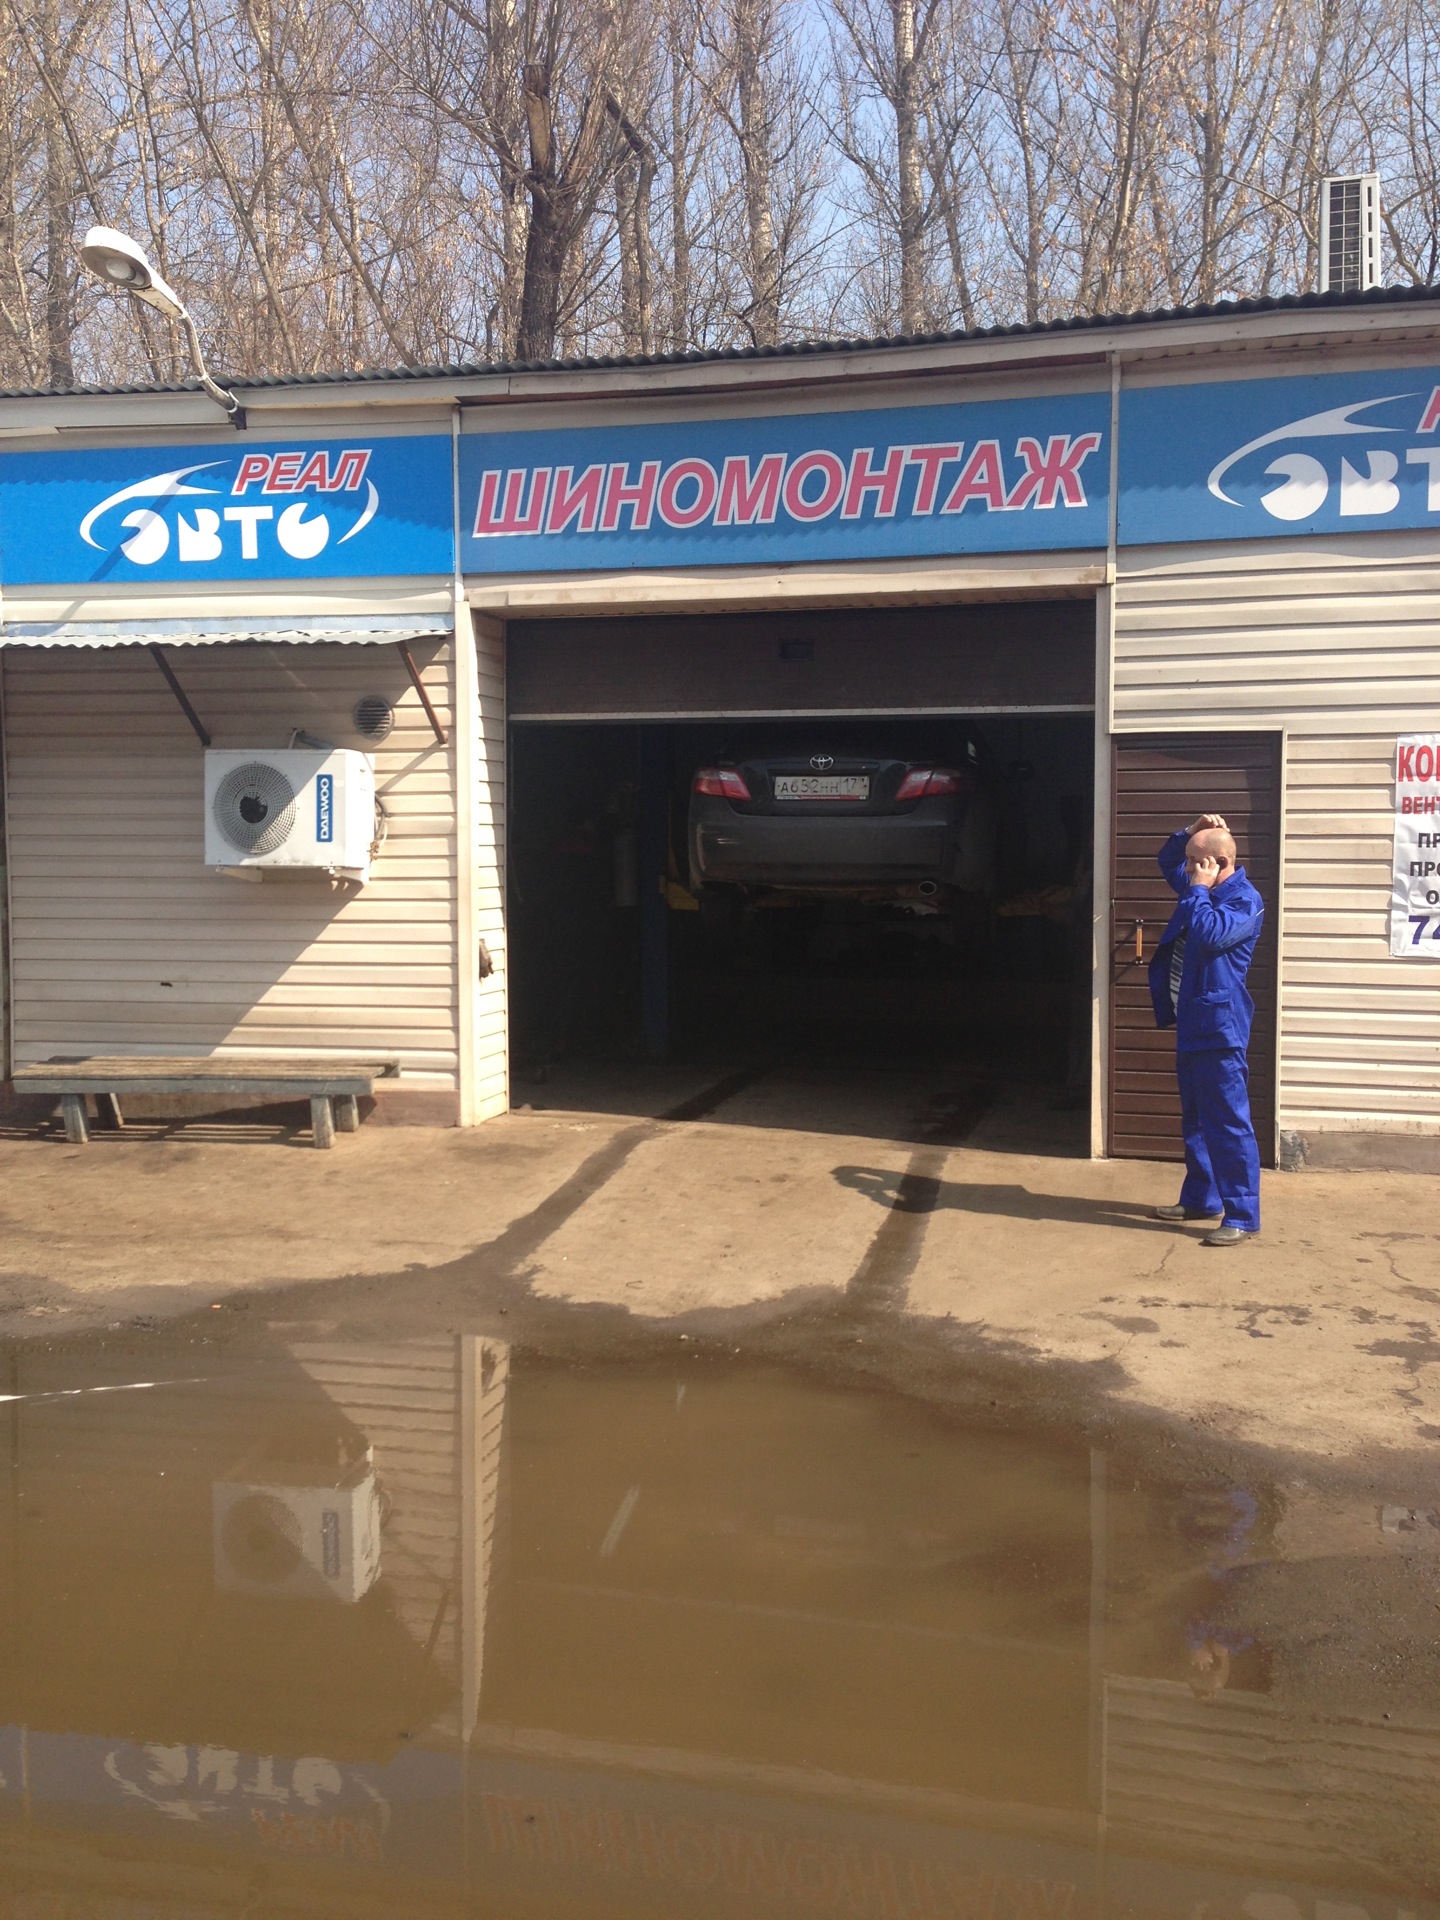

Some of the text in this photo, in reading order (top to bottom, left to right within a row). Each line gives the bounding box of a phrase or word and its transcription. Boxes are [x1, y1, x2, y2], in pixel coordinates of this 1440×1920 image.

[230, 449, 372, 495] РЕАЛ
[472, 432, 1102, 538] ШИНОМОНТАЖ
[1398, 745, 1440, 782] КО
[320, 777, 330, 839] DAEWOO
